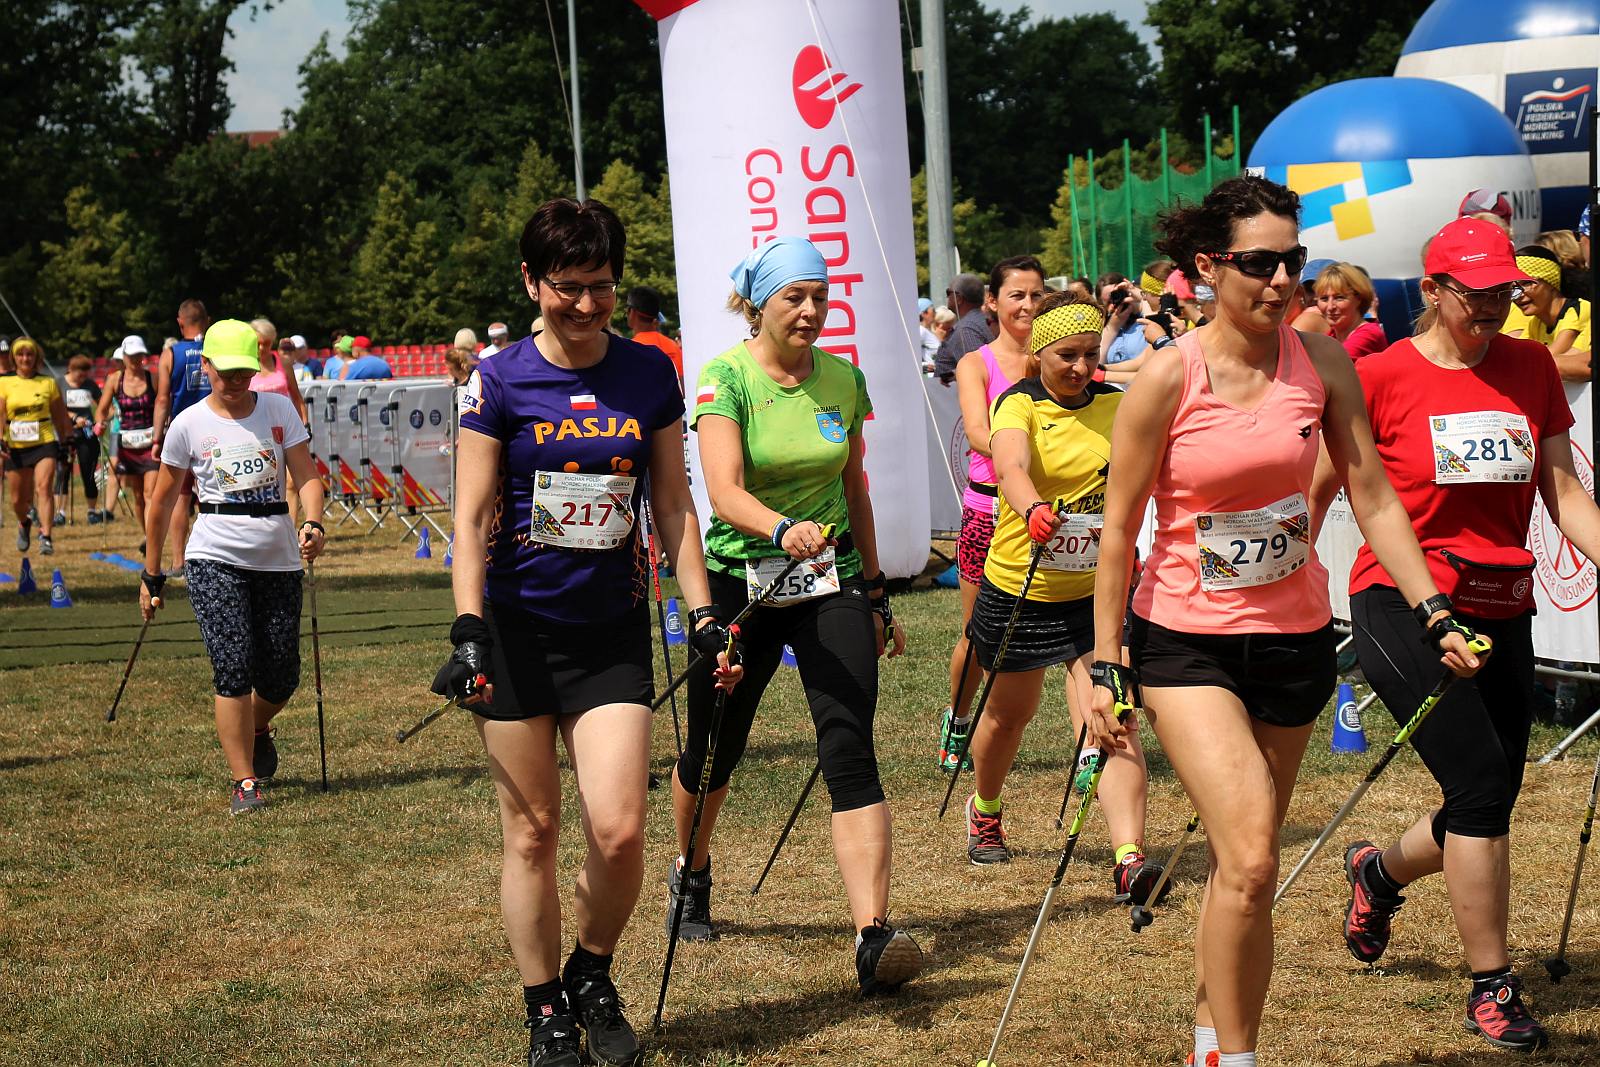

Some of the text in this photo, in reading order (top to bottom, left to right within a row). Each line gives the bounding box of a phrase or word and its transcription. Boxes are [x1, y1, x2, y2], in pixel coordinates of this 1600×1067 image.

[533, 417, 642, 445] PASJA
[1462, 438, 1513, 462] 281
[231, 457, 264, 477] 289
[560, 501, 613, 527] 217
[1052, 535, 1092, 555] 207
[1230, 533, 1288, 565] 279
[772, 573, 817, 597] 258
